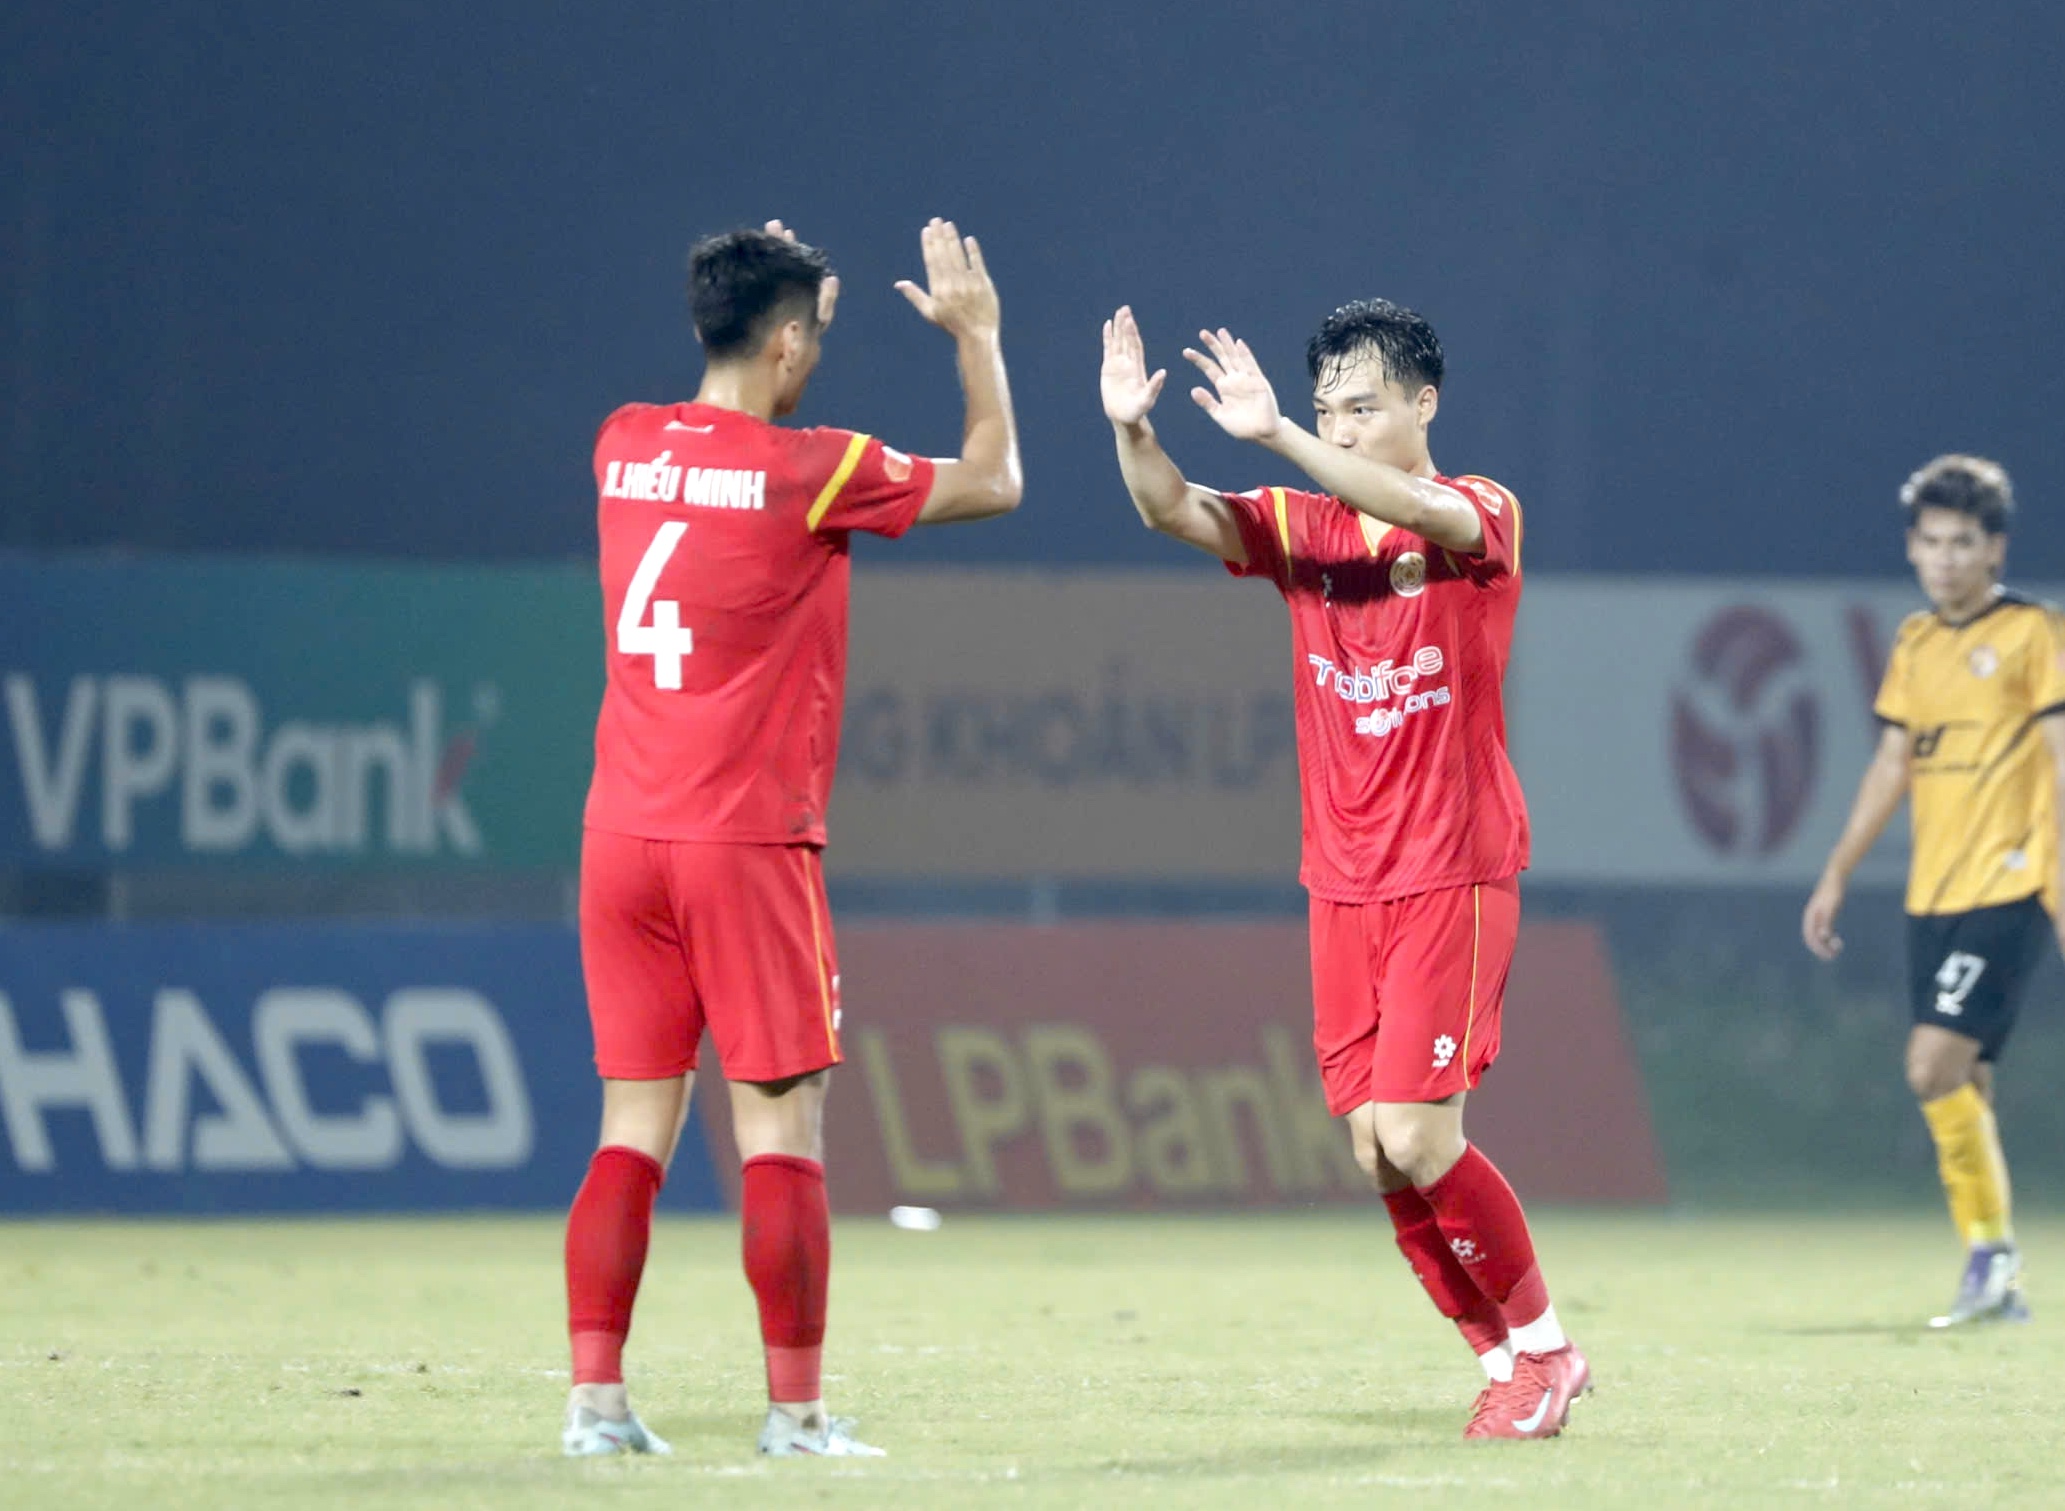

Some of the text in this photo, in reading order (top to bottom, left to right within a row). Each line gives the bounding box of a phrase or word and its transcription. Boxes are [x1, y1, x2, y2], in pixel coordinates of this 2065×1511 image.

[684, 467, 766, 510] MINH
[616, 521, 693, 690] 4
[6, 672, 484, 852] VPBank
[0, 986, 534, 1170] HACO
[856, 1021, 1376, 1194] LPBank
